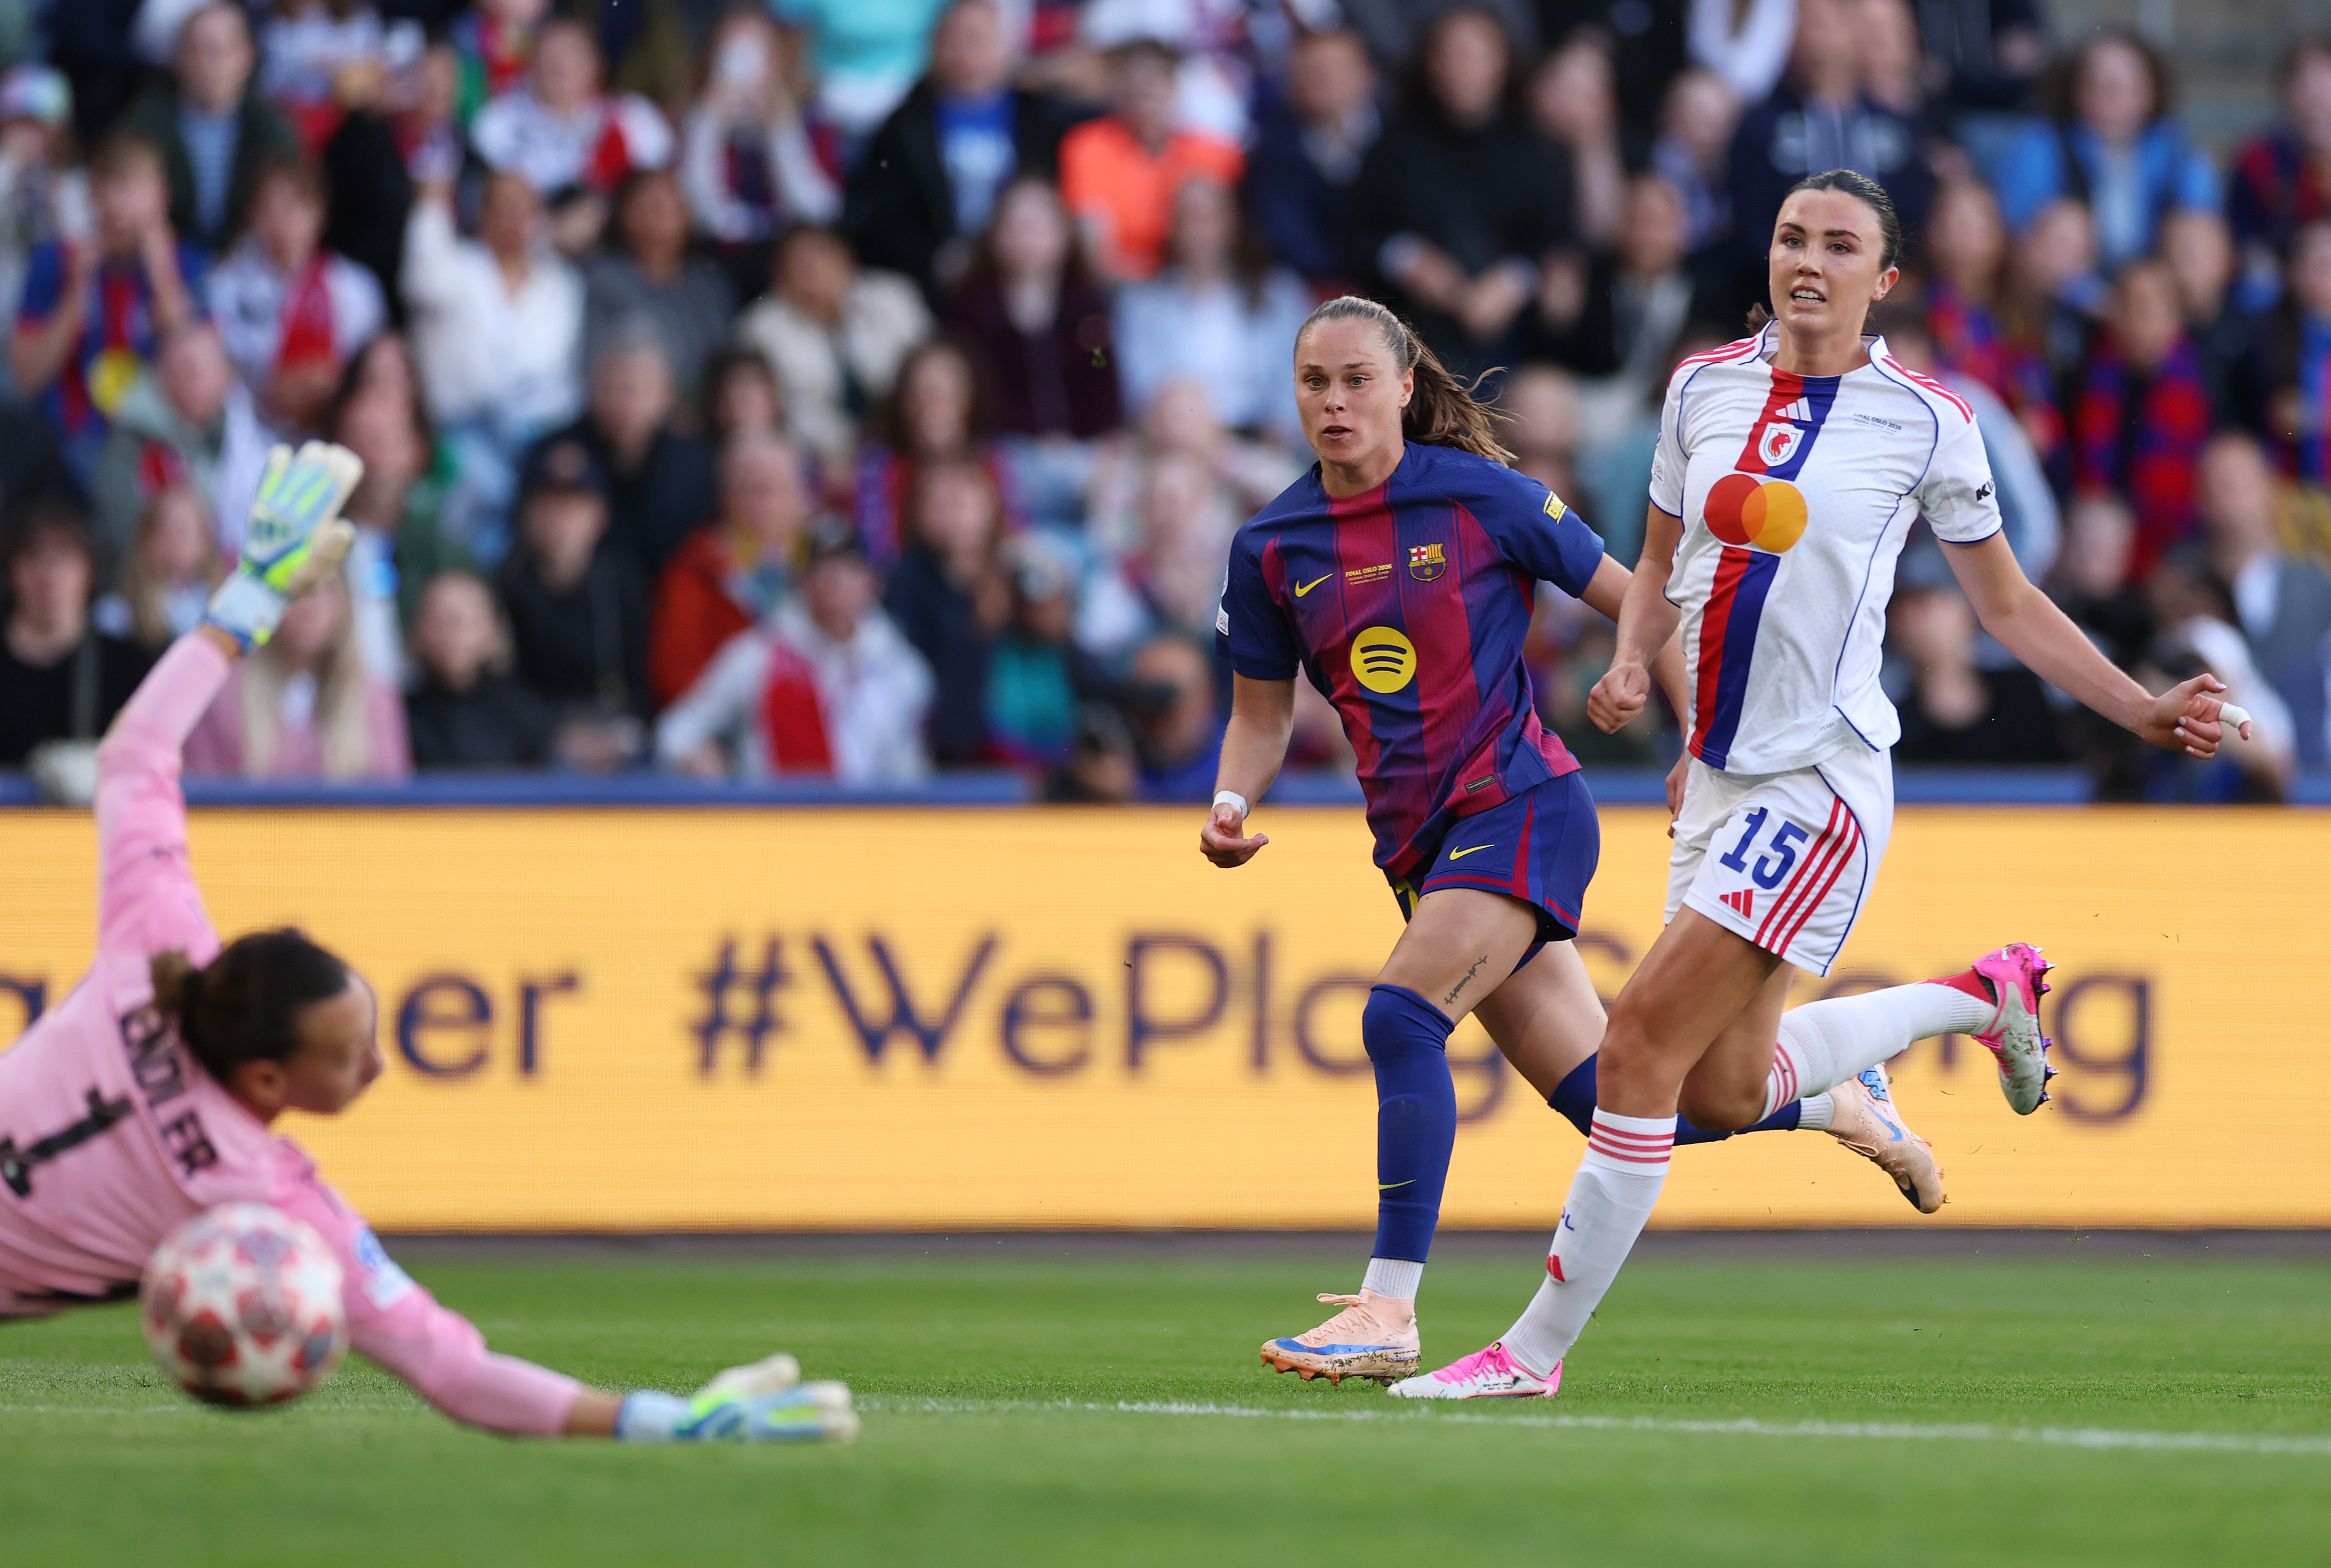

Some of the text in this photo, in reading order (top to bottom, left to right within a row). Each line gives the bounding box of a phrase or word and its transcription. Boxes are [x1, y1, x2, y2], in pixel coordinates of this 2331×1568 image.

[1719, 806, 1809, 890] 15
[0, 1087, 133, 1198] 1
[120, 1006, 218, 1179] ENDLER
